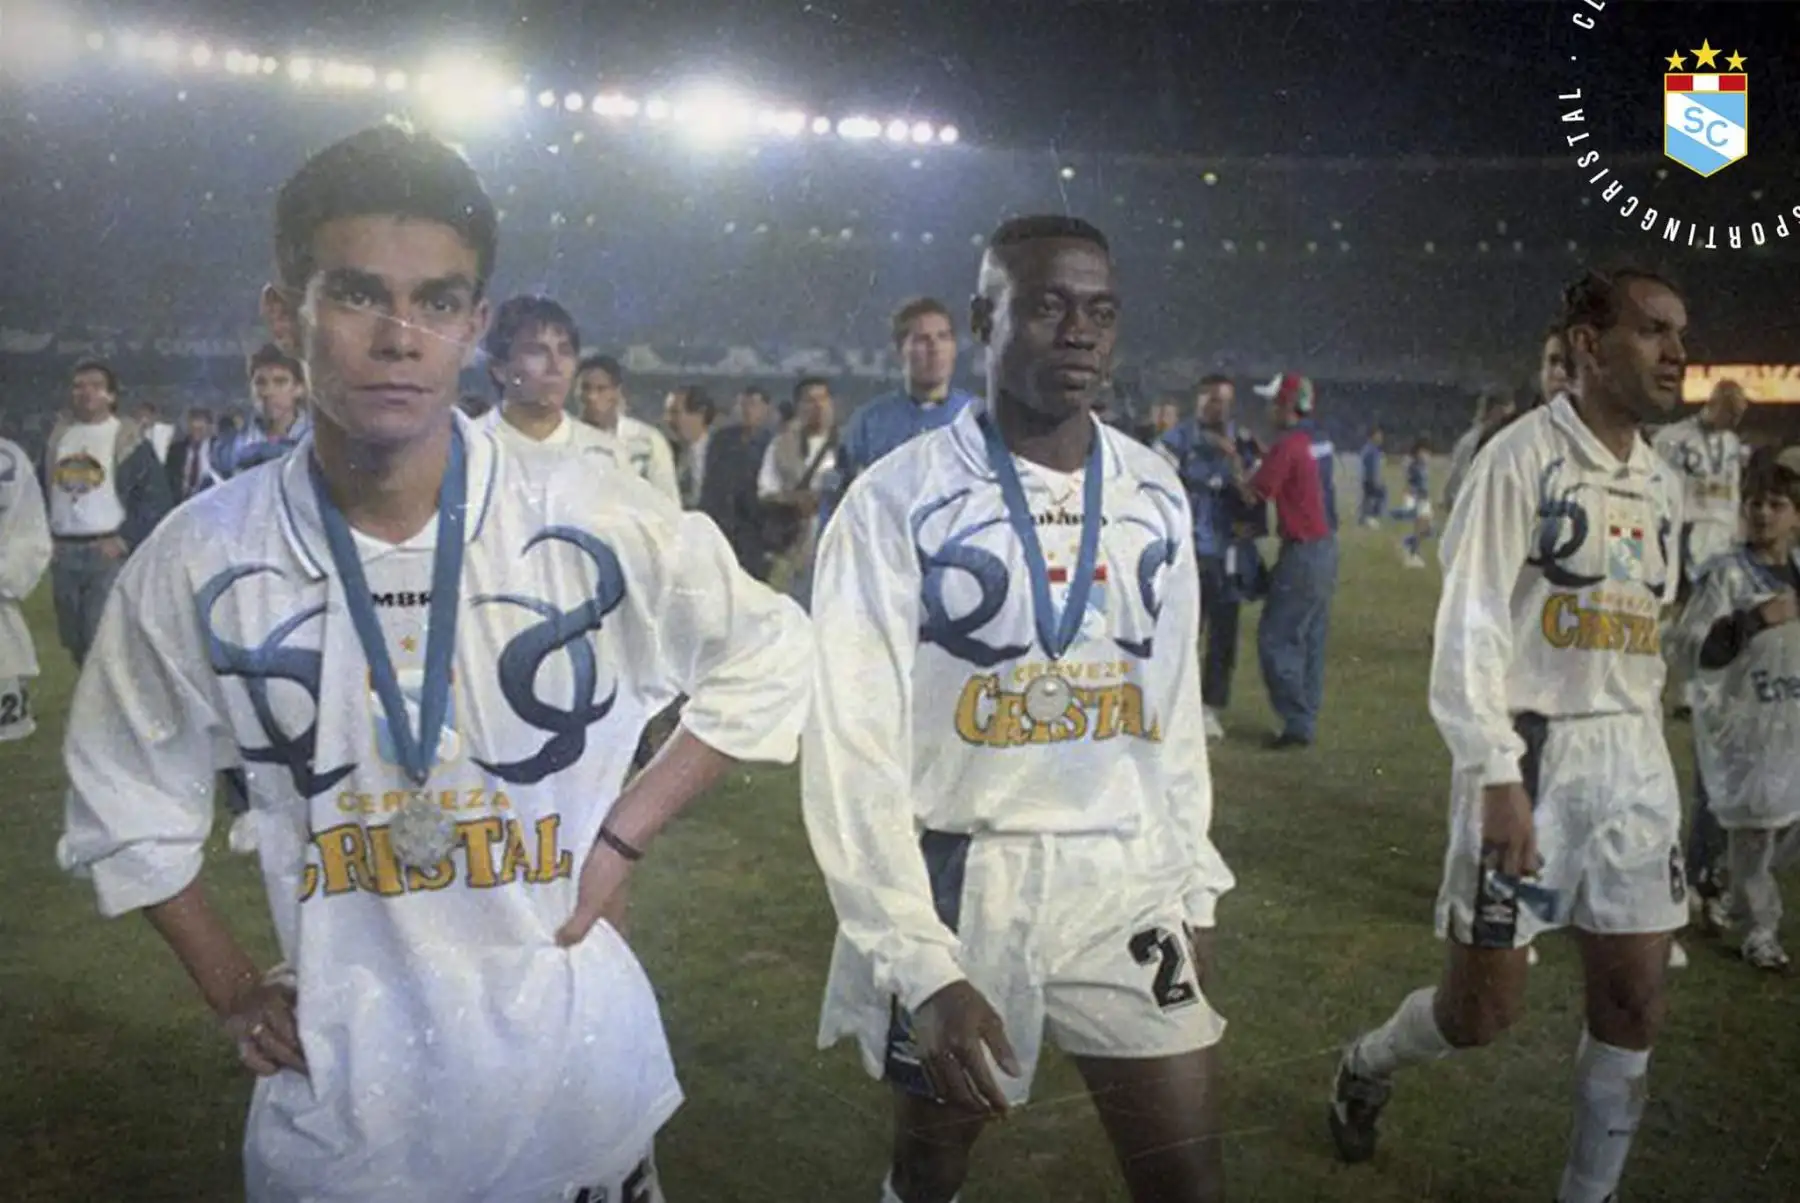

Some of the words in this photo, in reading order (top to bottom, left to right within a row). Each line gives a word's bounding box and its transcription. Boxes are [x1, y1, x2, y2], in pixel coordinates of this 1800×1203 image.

[337, 787, 511, 813] CEREZA
[297, 813, 574, 903] RITAL
[1127, 926, 1200, 1013] 2
